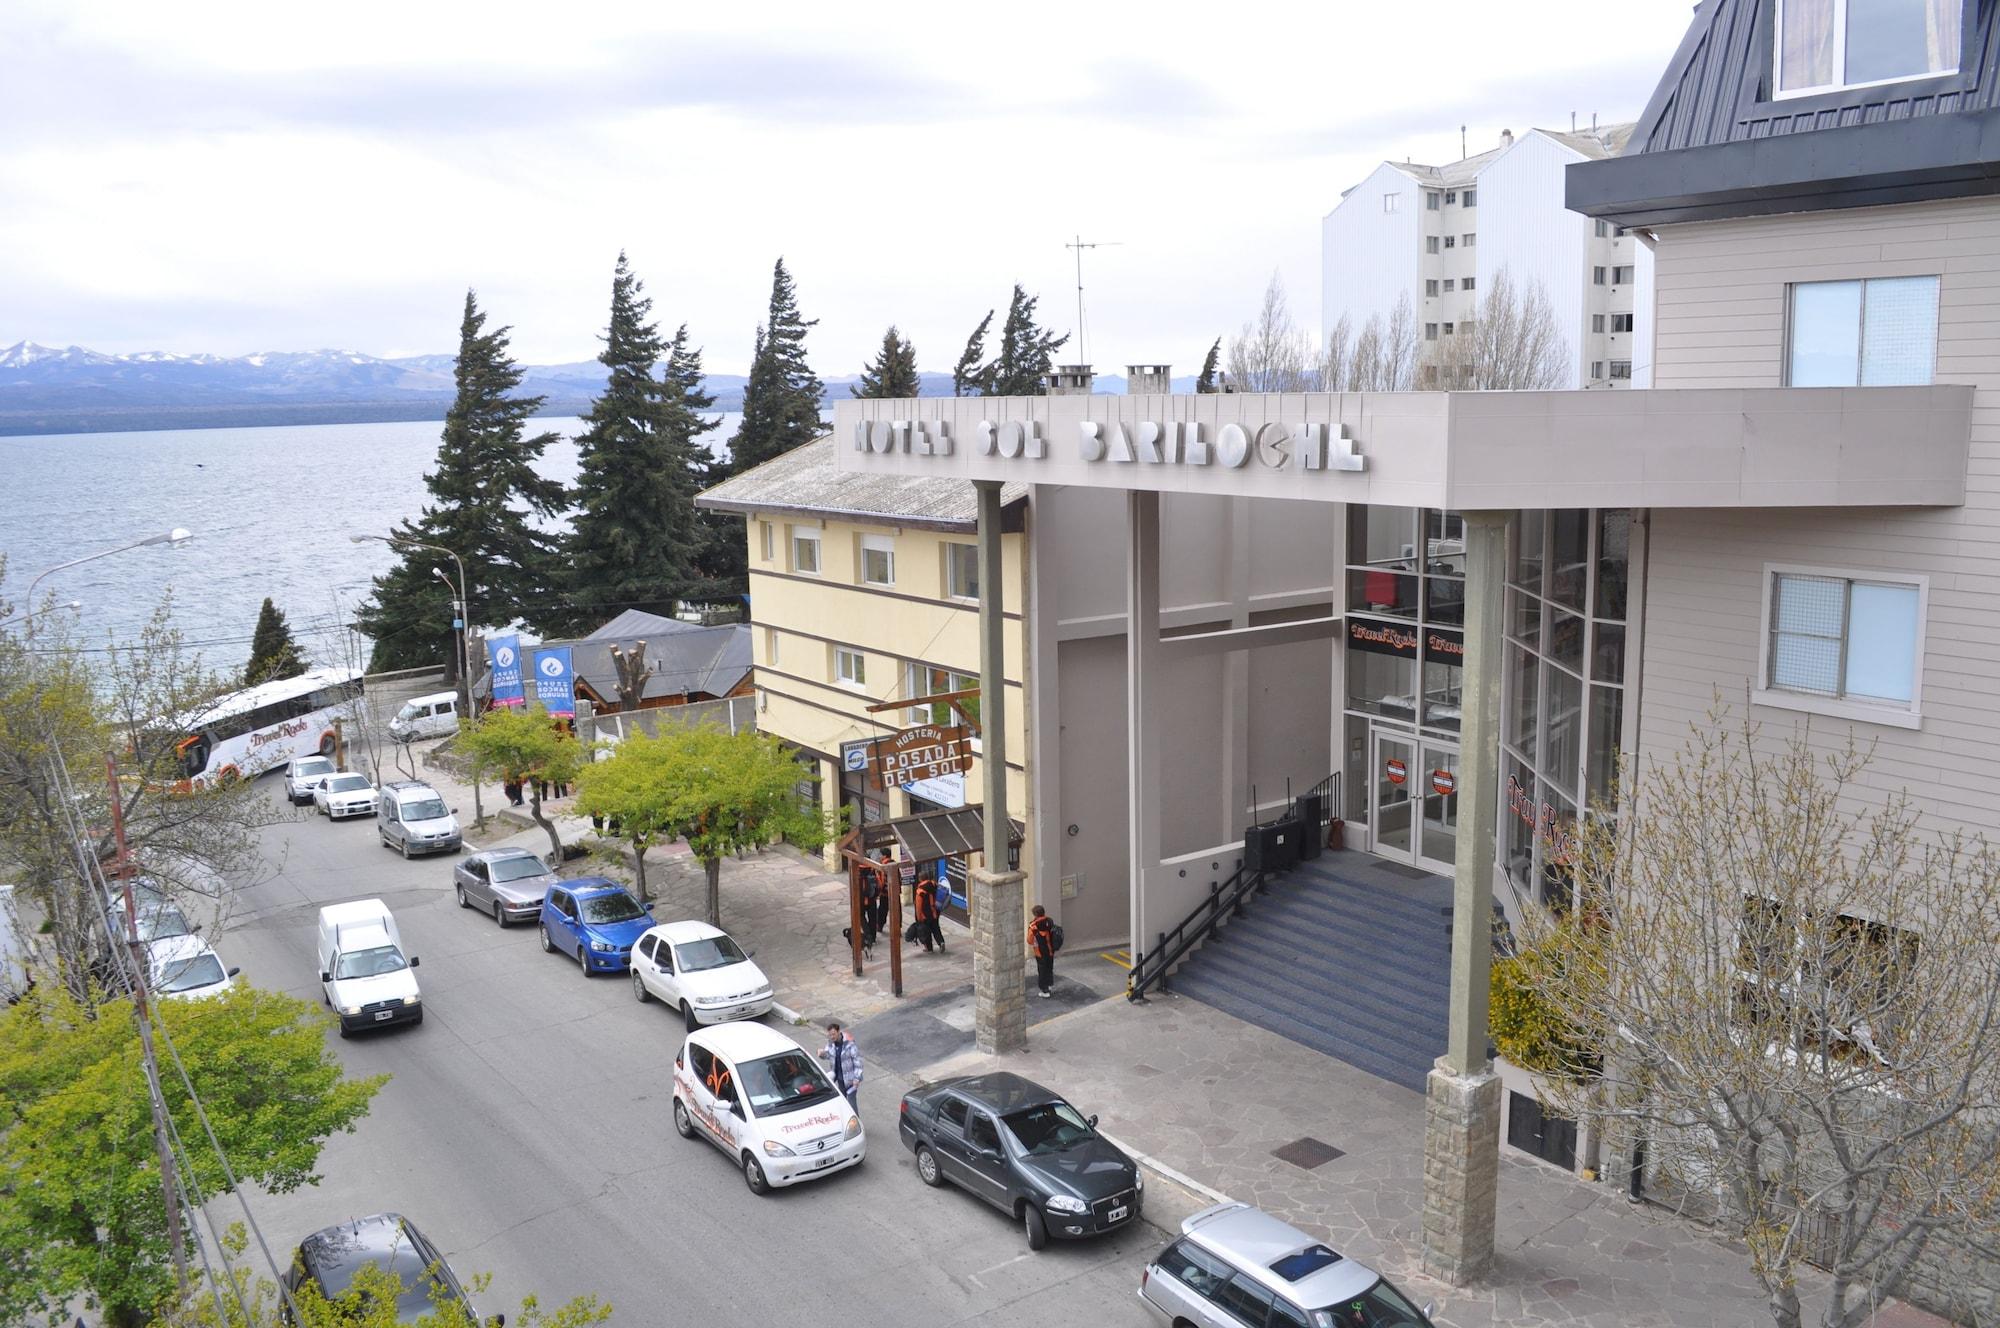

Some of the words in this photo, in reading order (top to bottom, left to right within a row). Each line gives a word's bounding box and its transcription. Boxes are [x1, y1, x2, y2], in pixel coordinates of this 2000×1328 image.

[855, 420, 953, 457] HOTEL
[977, 420, 1047, 459] SOL
[1079, 420, 1369, 472] BARILOCHE
[895, 728, 942, 748] HOSTERIA
[886, 744, 956, 770] POSADA
[884, 768, 918, 787] DEL
[928, 760, 961, 778] SOL
